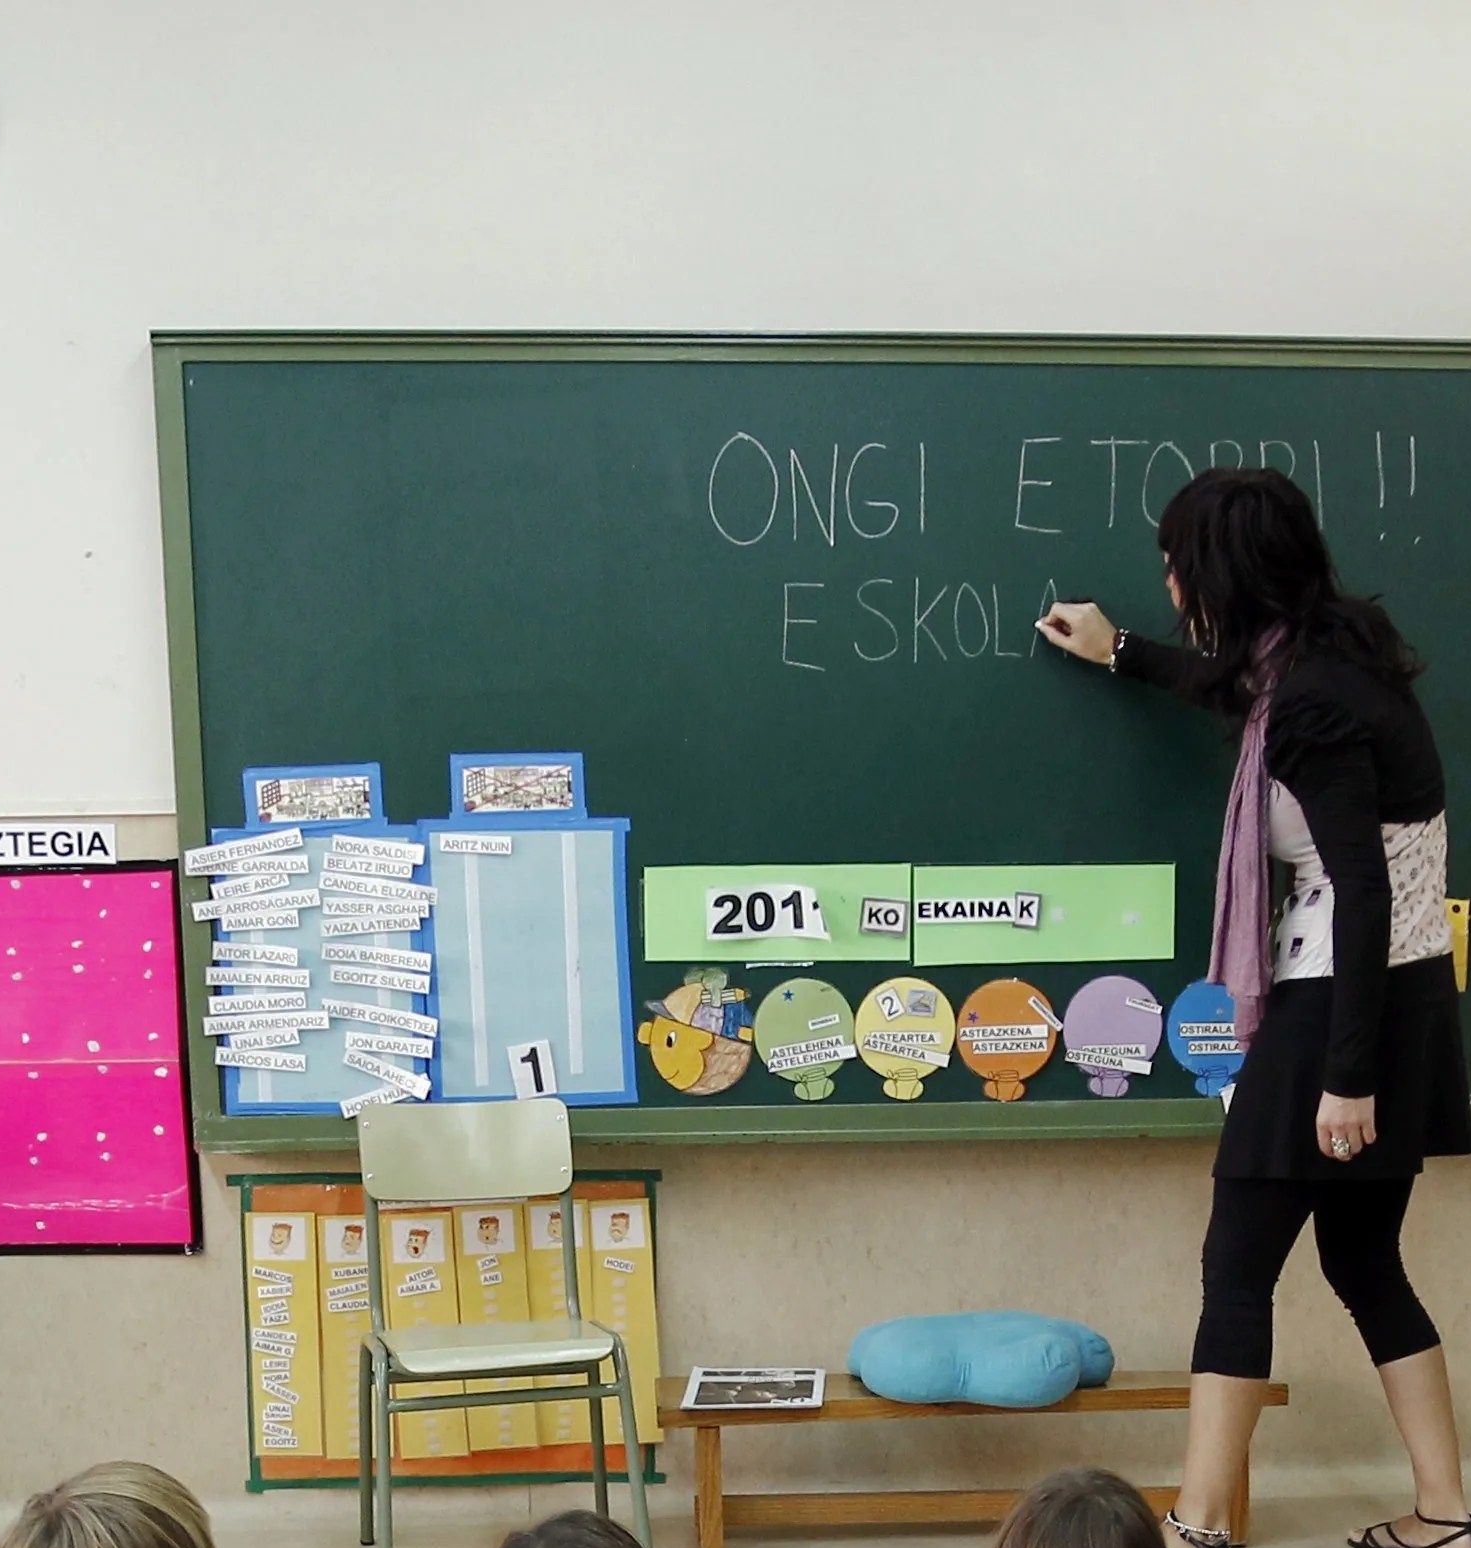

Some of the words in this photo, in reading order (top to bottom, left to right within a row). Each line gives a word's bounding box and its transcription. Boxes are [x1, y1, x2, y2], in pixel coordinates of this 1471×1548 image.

[709, 430, 928, 548] ONGI
[190, 849, 228, 866] ASIER
[228, 834, 301, 858] FERNANDEZ
[335, 840, 370, 855] NORA
[443, 838, 478, 851] ARITZ
[480, 840, 511, 853] NUIN
[241, 860, 308, 873] GARRALDA
[327, 857, 373, 873] BELATZ
[375, 861, 411, 876] IRUJO
[216, 883, 252, 898] LEIRE
[253, 875, 287, 888] ARCA
[322, 877, 379, 894] CANDELA
[381, 885, 437, 905] ELIZALDE
[197, 904, 223, 919] ANE
[225, 893, 316, 914] ARROSAGARAY
[325, 902, 374, 914] YASSER
[377, 903, 428, 916] ASGHAR
[226, 916, 265, 930] AIMAR
[867, 907, 900, 926] KO
[323, 919, 359, 934] YAIZA
[360, 917, 419, 932] LATIENDA
[215, 947, 251, 960] AITOR
[253, 949, 297, 964] LAZARO
[324, 947, 358, 961] IDOIA
[359, 950, 429, 969] BARBERENA
[209, 972, 262, 984] MAIALEN
[264, 974, 308, 986] ARRUIZ
[333, 970, 378, 985] EGOITZ
[379, 975, 427, 991] SILVELA
[213, 999, 265, 1013] CLAUDIA
[267, 996, 305, 1009] MORO
[881, 996, 899, 1018] 2
[208, 1019, 247, 1033] AIMAR
[248, 1016, 325, 1030] ARMENDARIZ
[368, 1011, 437, 1034] GOIKOETXEA
[1179, 1024, 1233, 1036] OSTIRALA
[234, 1037, 264, 1051] UNAI
[266, 1032, 298, 1046] SOLA
[960, 1026, 1033, 1040] ASTEAZKENA
[348, 1036, 374, 1050] JON
[375, 1039, 430, 1056] GARATEA
[770, 1038, 842, 1059] ASTELEHENA
[863, 1038, 927, 1061] ASTEARTEA
[973, 1040, 1046, 1053] ASTEAZKENA
[219, 1052, 272, 1067] MARCOS
[274, 1057, 305, 1070] LASA
[346, 1053, 382, 1077] SAIOA
[768, 1050, 841, 1070] ASTELEHENA
[1065, 1050, 1125, 1068] OSTEGUNA
[519, 1046, 545, 1094] 1
[606, 1258, 634, 1272] HODEI
[254, 1267, 293, 1284] MARCOS
[409, 1268, 435, 1283] AITOR
[482, 1272, 501, 1284] ANE
[399, 1282, 428, 1294] AIMAR
[329, 1300, 369, 1311] CLAUDIA
[254, 1329, 296, 1342] CANDELA
[255, 1341, 283, 1354] AIMAR
[264, 1438, 297, 1447] EGOITZ
